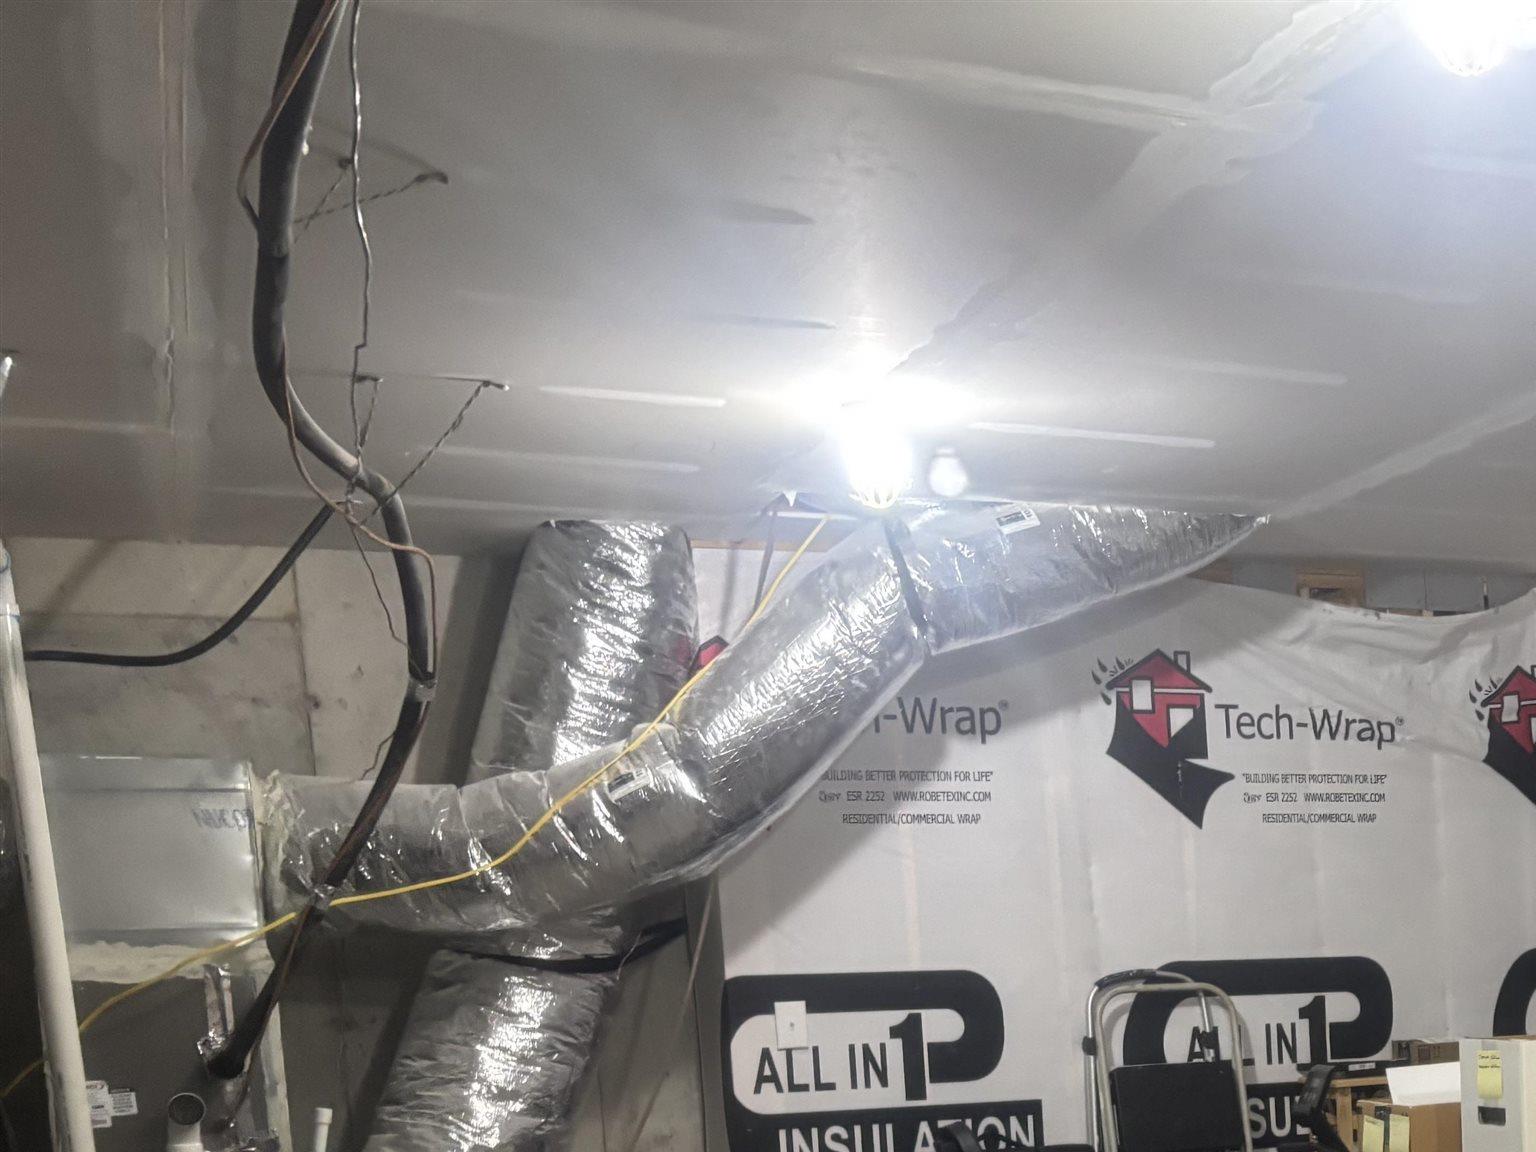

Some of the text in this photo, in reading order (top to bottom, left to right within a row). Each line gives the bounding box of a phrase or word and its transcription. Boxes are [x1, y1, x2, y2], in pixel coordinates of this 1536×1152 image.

[874, 697, 1002, 744] -Wrap
[1214, 704, 1396, 750] Tech-Wrap
[865, 770, 896, 781] BETTER
[899, 770, 951, 782] PROTECTION
[954, 771, 971, 782] FOR
[1281, 773, 1306, 784] BETTER
[1308, 773, 1353, 784] PROTECTION
[846, 790, 863, 801] ESR
[866, 790, 885, 801] 2252
[893, 791, 991, 802] WWW.ROBETEXINC.COM
[842, 813, 981, 825] RESIDENTIAL/COMMERCIAL WRAP
[1265, 1022, 1297, 1065] IN
[1298, 995, 1330, 1068] 1
[754, 1013, 928, 1101] ALL IN 1
